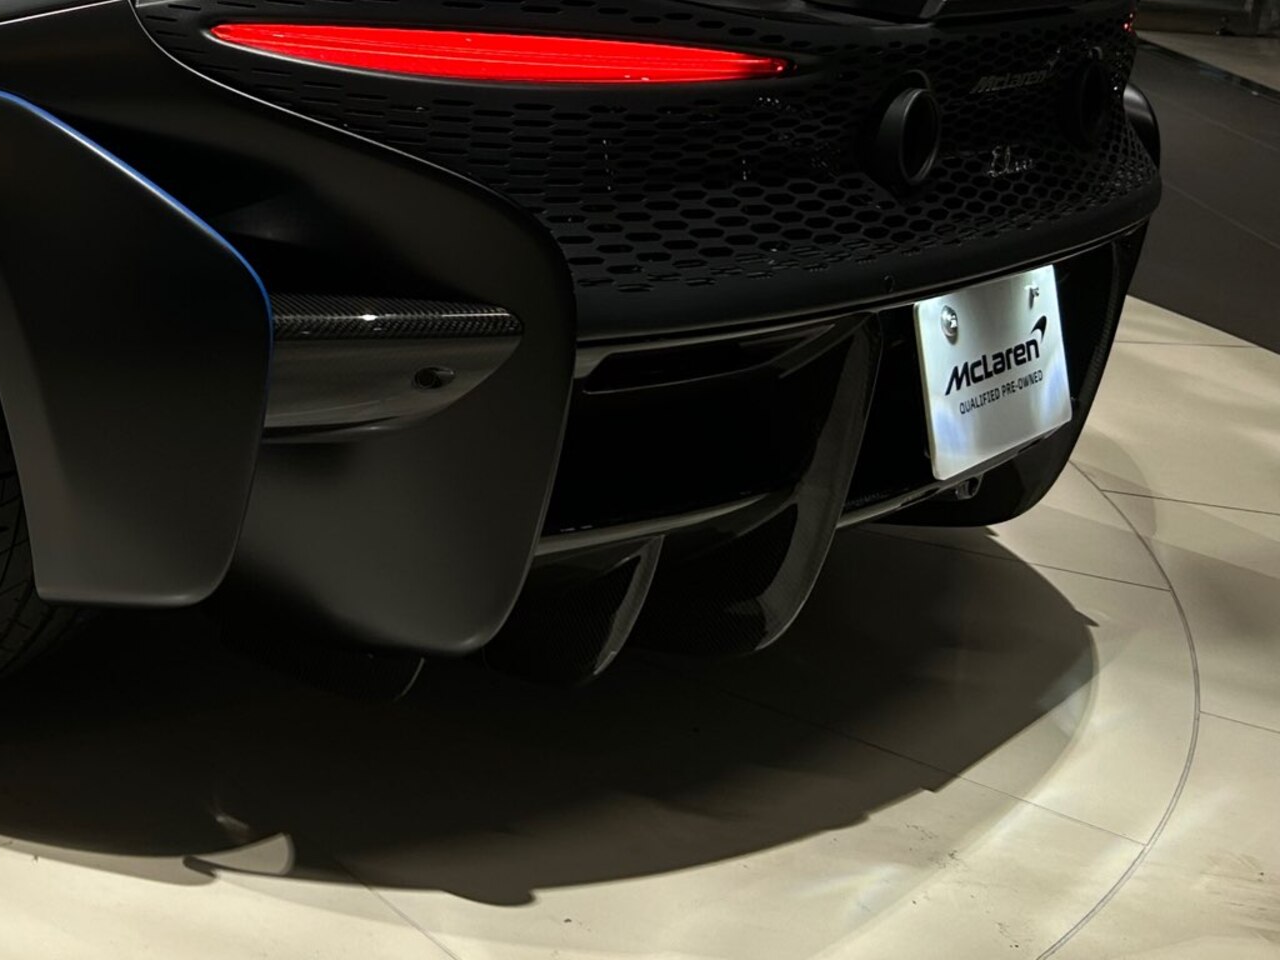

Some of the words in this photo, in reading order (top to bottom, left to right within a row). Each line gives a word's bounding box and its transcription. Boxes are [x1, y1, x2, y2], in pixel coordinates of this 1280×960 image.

[968, 69, 1048, 95] McLaren
[944, 338, 1040, 396] McLaren
[959, 387, 1001, 415] QUALIFIED
[1001, 369, 1044, 398] PRE-OWNED
